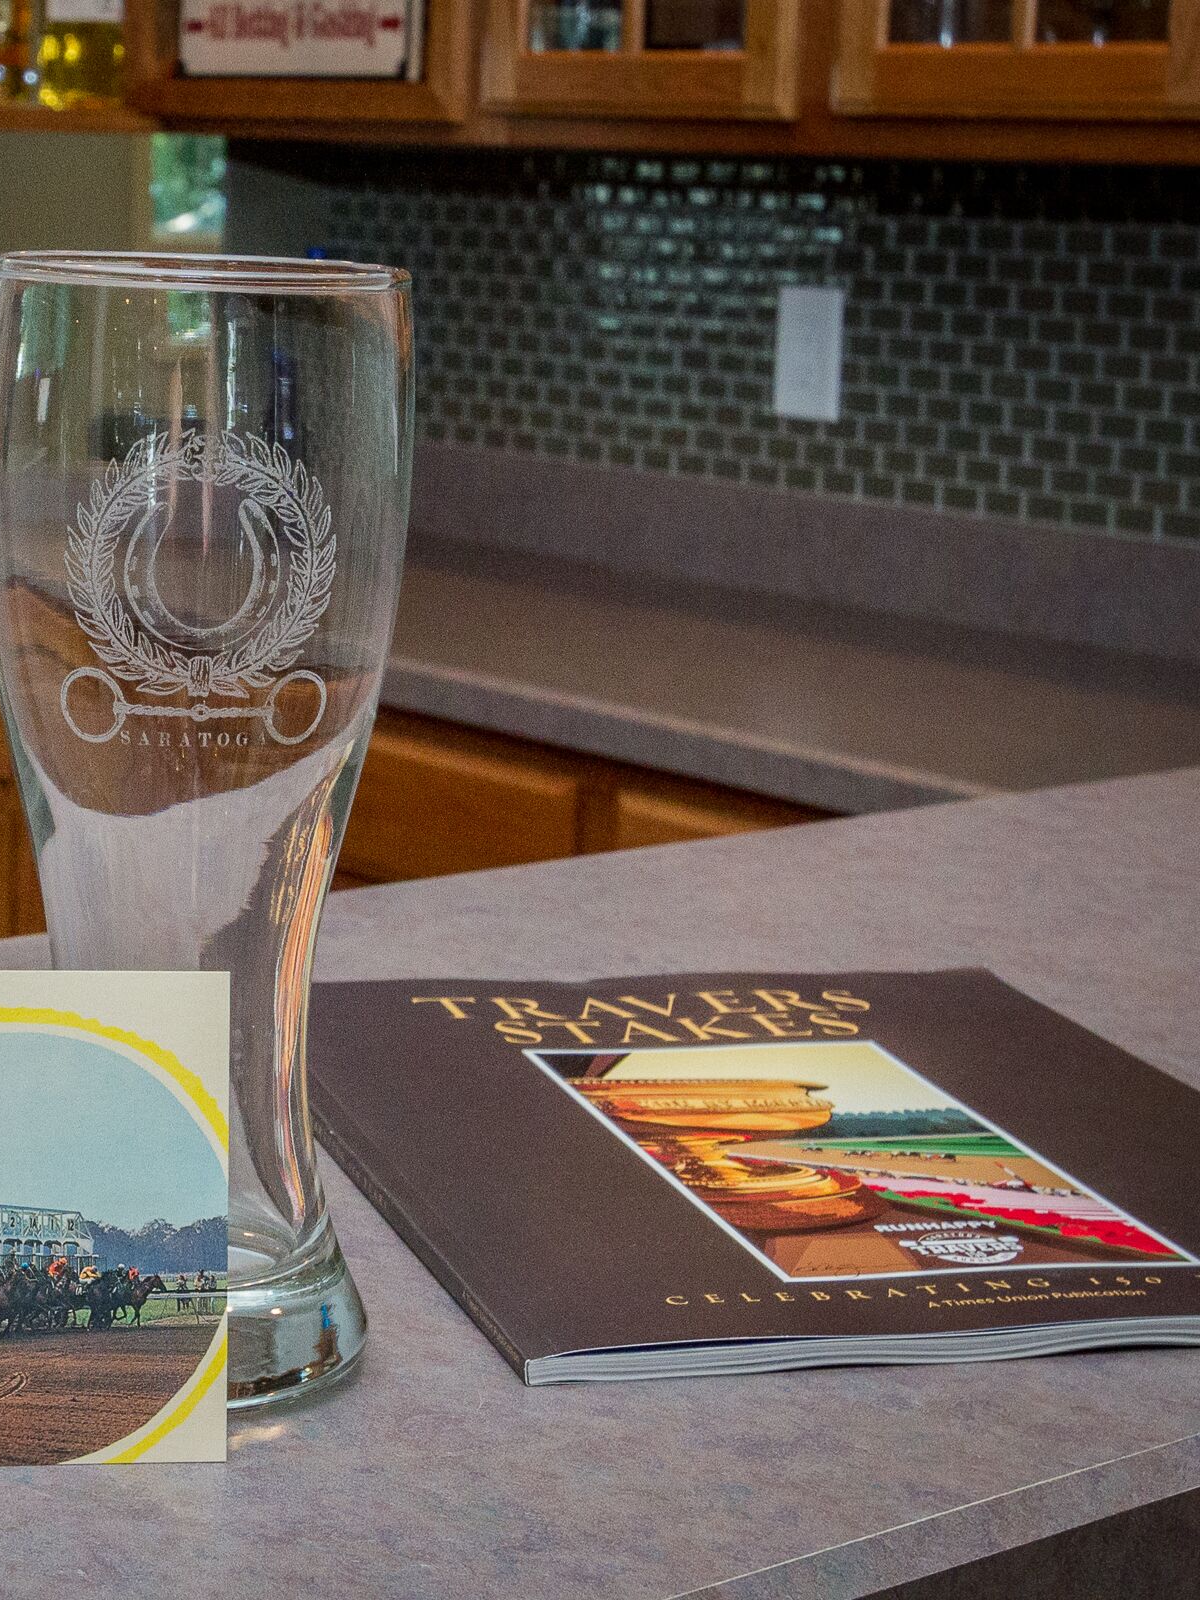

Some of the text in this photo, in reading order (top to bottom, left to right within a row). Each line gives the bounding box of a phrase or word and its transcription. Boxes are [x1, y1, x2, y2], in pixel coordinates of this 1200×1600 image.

[412, 989, 871, 1019] TRAVERS
[494, 1012, 859, 1044] STAKES
[9, 1216, 16, 1228] 2
[66, 1218, 75, 1232] 12
[873, 1220, 997, 1233] RUNHAPPY
[909, 1239, 1025, 1257] TRAVERS
[666, 1276, 1162, 1306] CELEBRATING 150
[928, 1289, 1147, 1309] A Times Union Publication
